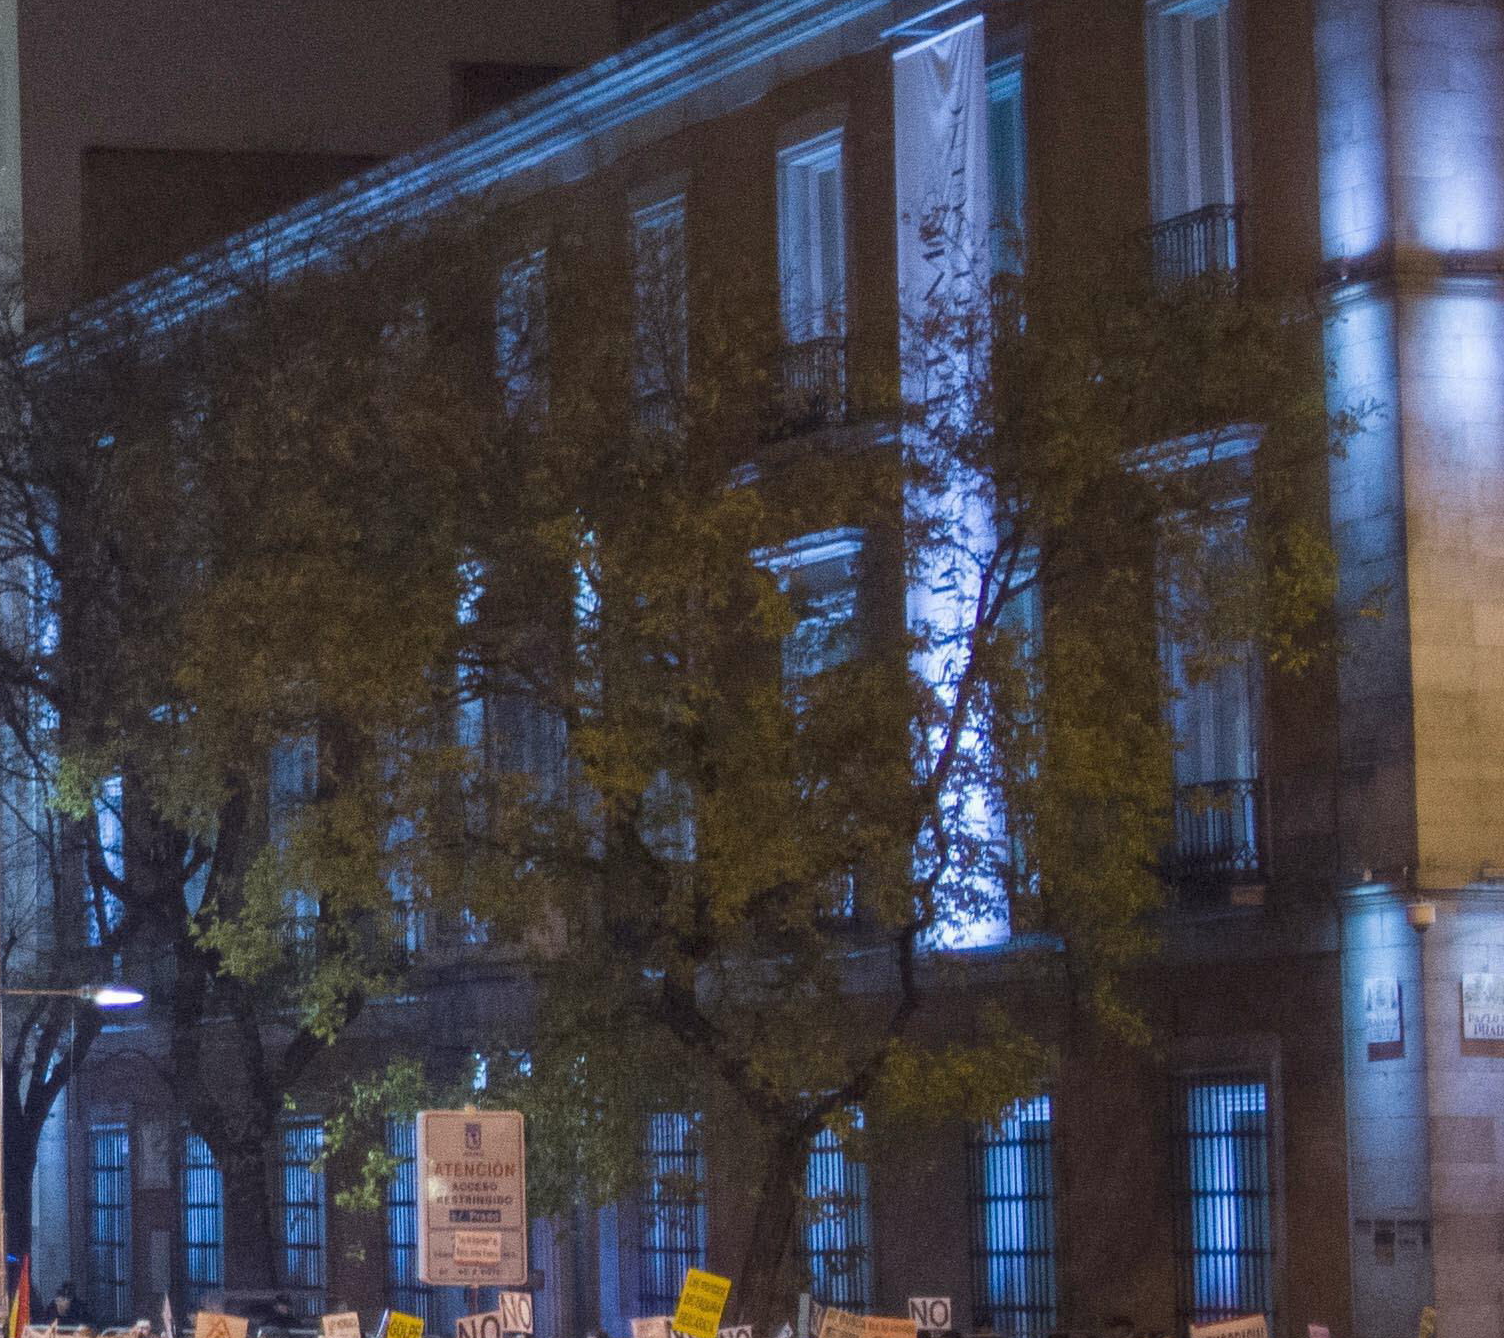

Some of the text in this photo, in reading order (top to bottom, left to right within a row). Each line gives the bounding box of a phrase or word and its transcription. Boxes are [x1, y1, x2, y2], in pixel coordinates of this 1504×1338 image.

[434, 1160, 516, 1178] ATENCIÓN
[452, 1181, 498, 1192] ACCESO
[501, 1294, 532, 1330] NO
[911, 1300, 949, 1327] NO
